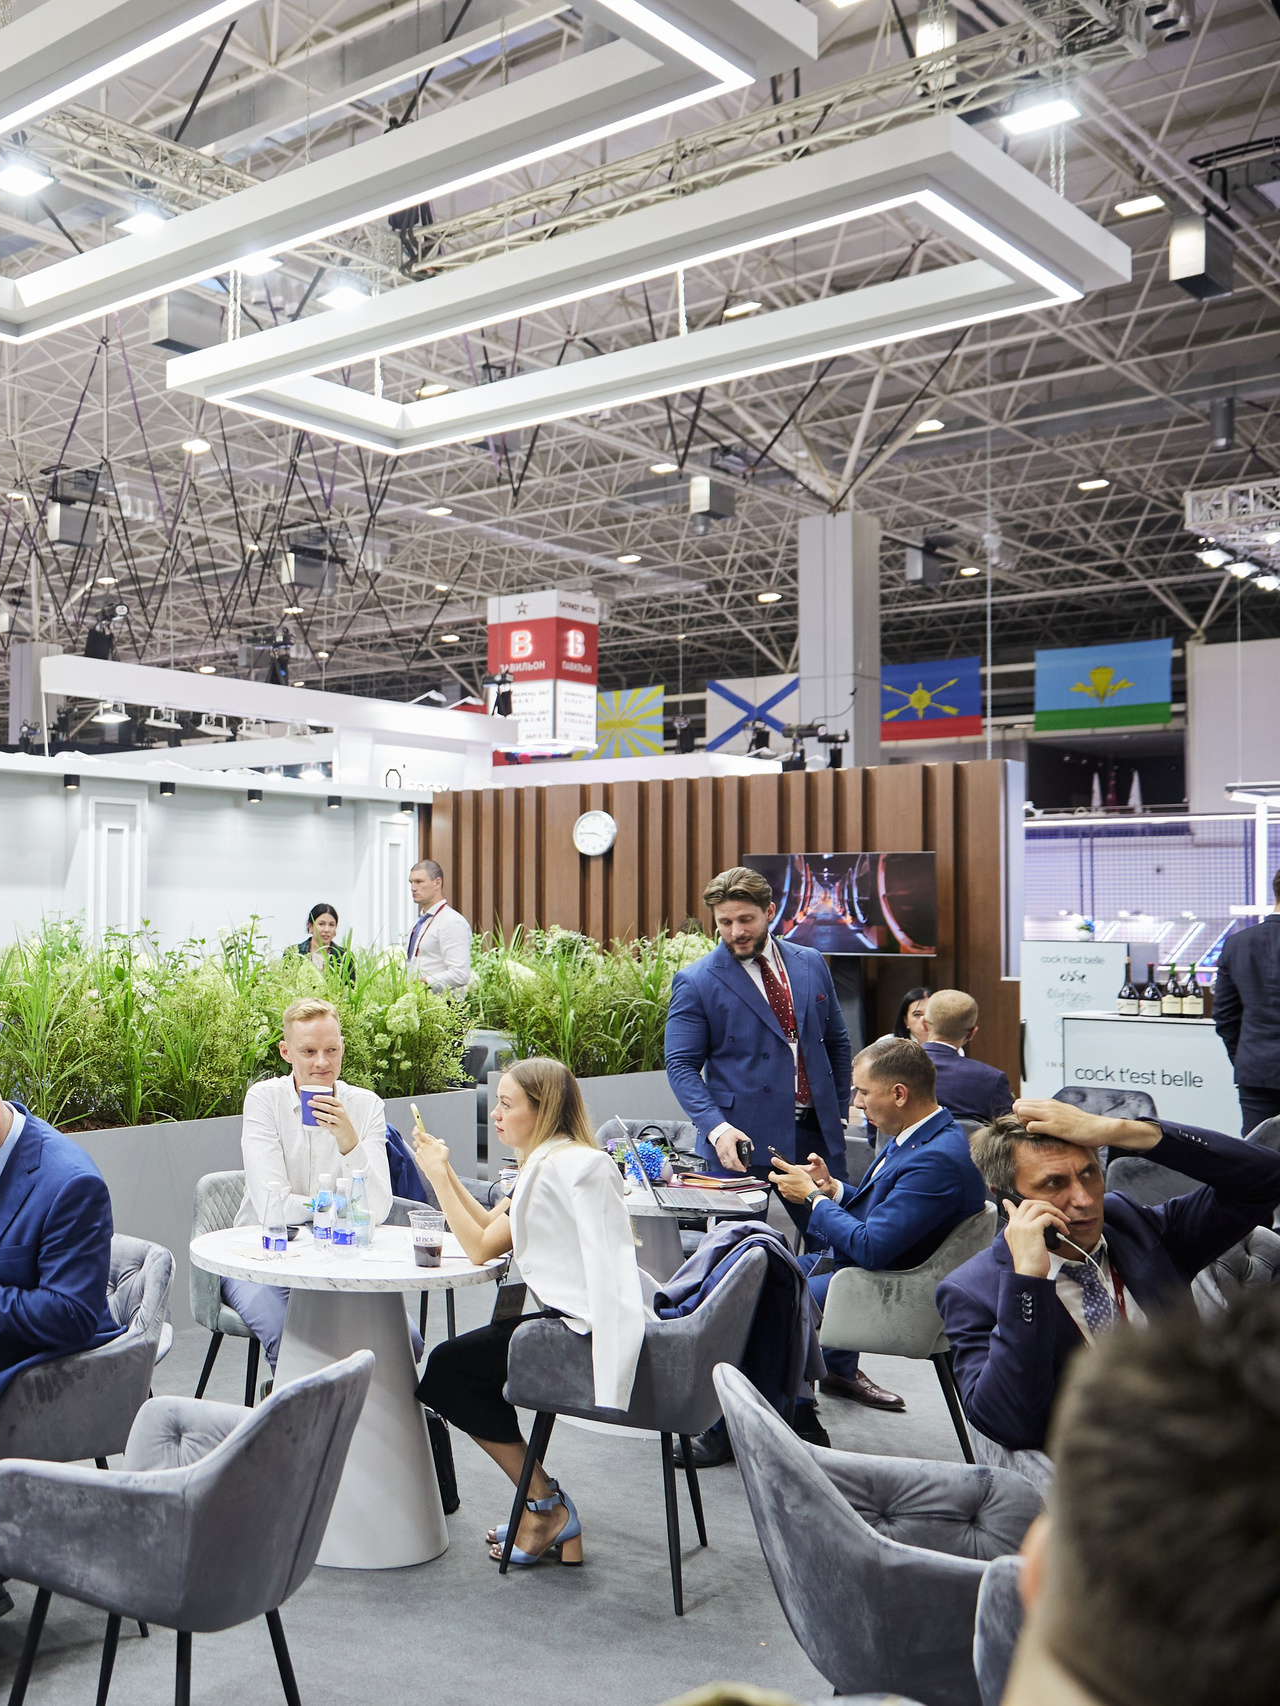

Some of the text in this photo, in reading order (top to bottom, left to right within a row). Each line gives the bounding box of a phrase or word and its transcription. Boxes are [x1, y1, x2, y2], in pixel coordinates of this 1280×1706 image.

[511, 630, 533, 658] В
[567, 629, 586, 658] В
[500, 660, 546, 674] ПАВИЛЬОН
[562, 660, 592, 674] ПАВИЛЬОН
[1075, 1066, 1116, 1082] cock
[1161, 1069, 1204, 1088] belle
